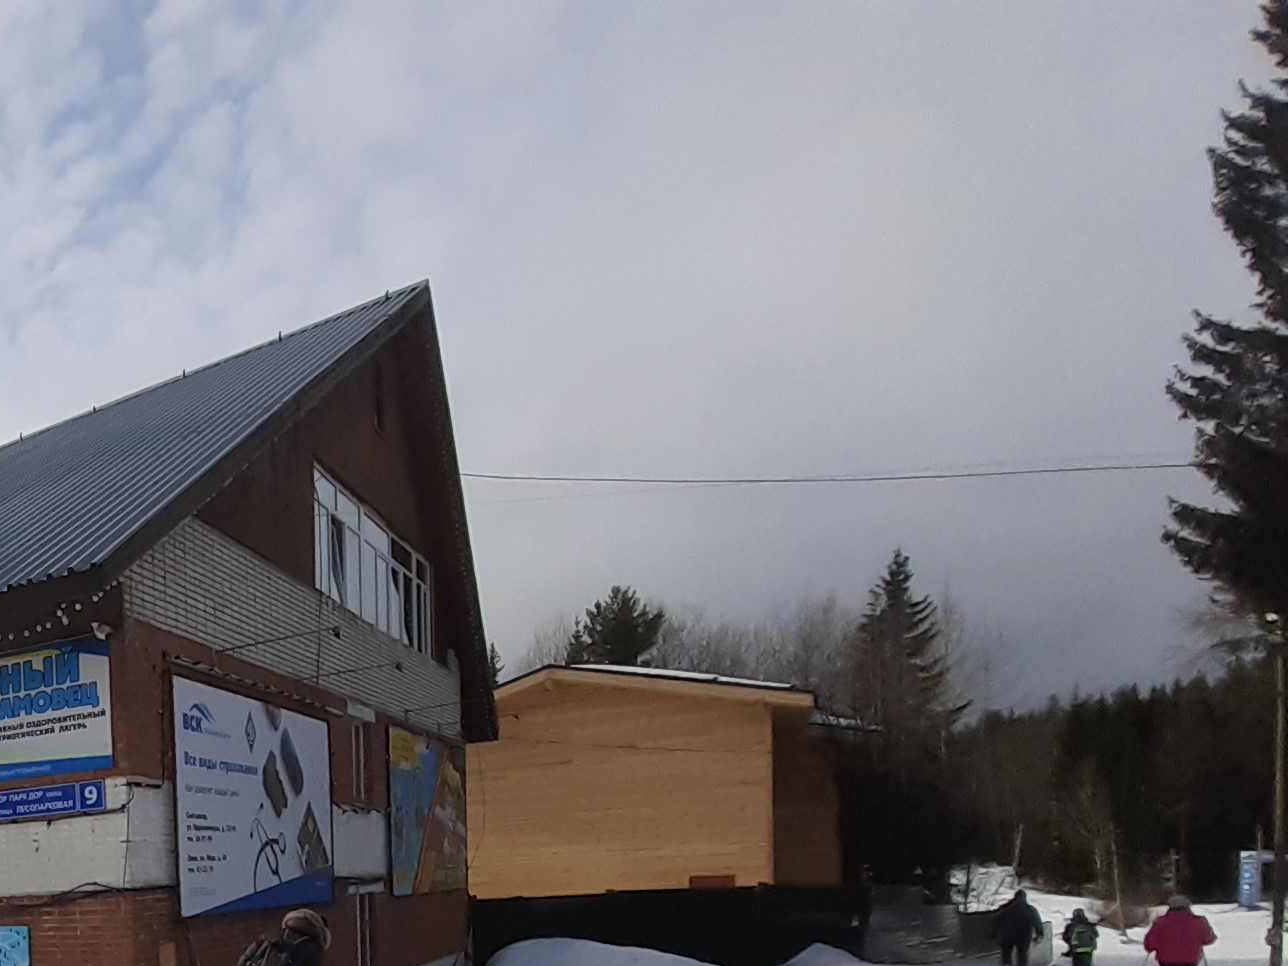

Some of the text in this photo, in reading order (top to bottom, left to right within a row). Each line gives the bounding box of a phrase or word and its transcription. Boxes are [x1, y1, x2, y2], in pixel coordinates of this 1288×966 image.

[26, 708, 106, 728] ОЗДОРОВИТЕЛЬНЫЙ
[182, 712, 203, 733] ВСК
[59, 723, 88, 733] ЛАГЕРЬ
[184, 751, 197, 767] Все
[9, 793, 27, 802] ПАРК
[28, 791, 44, 800] ДОР
[84, 785, 98, 805] 9
